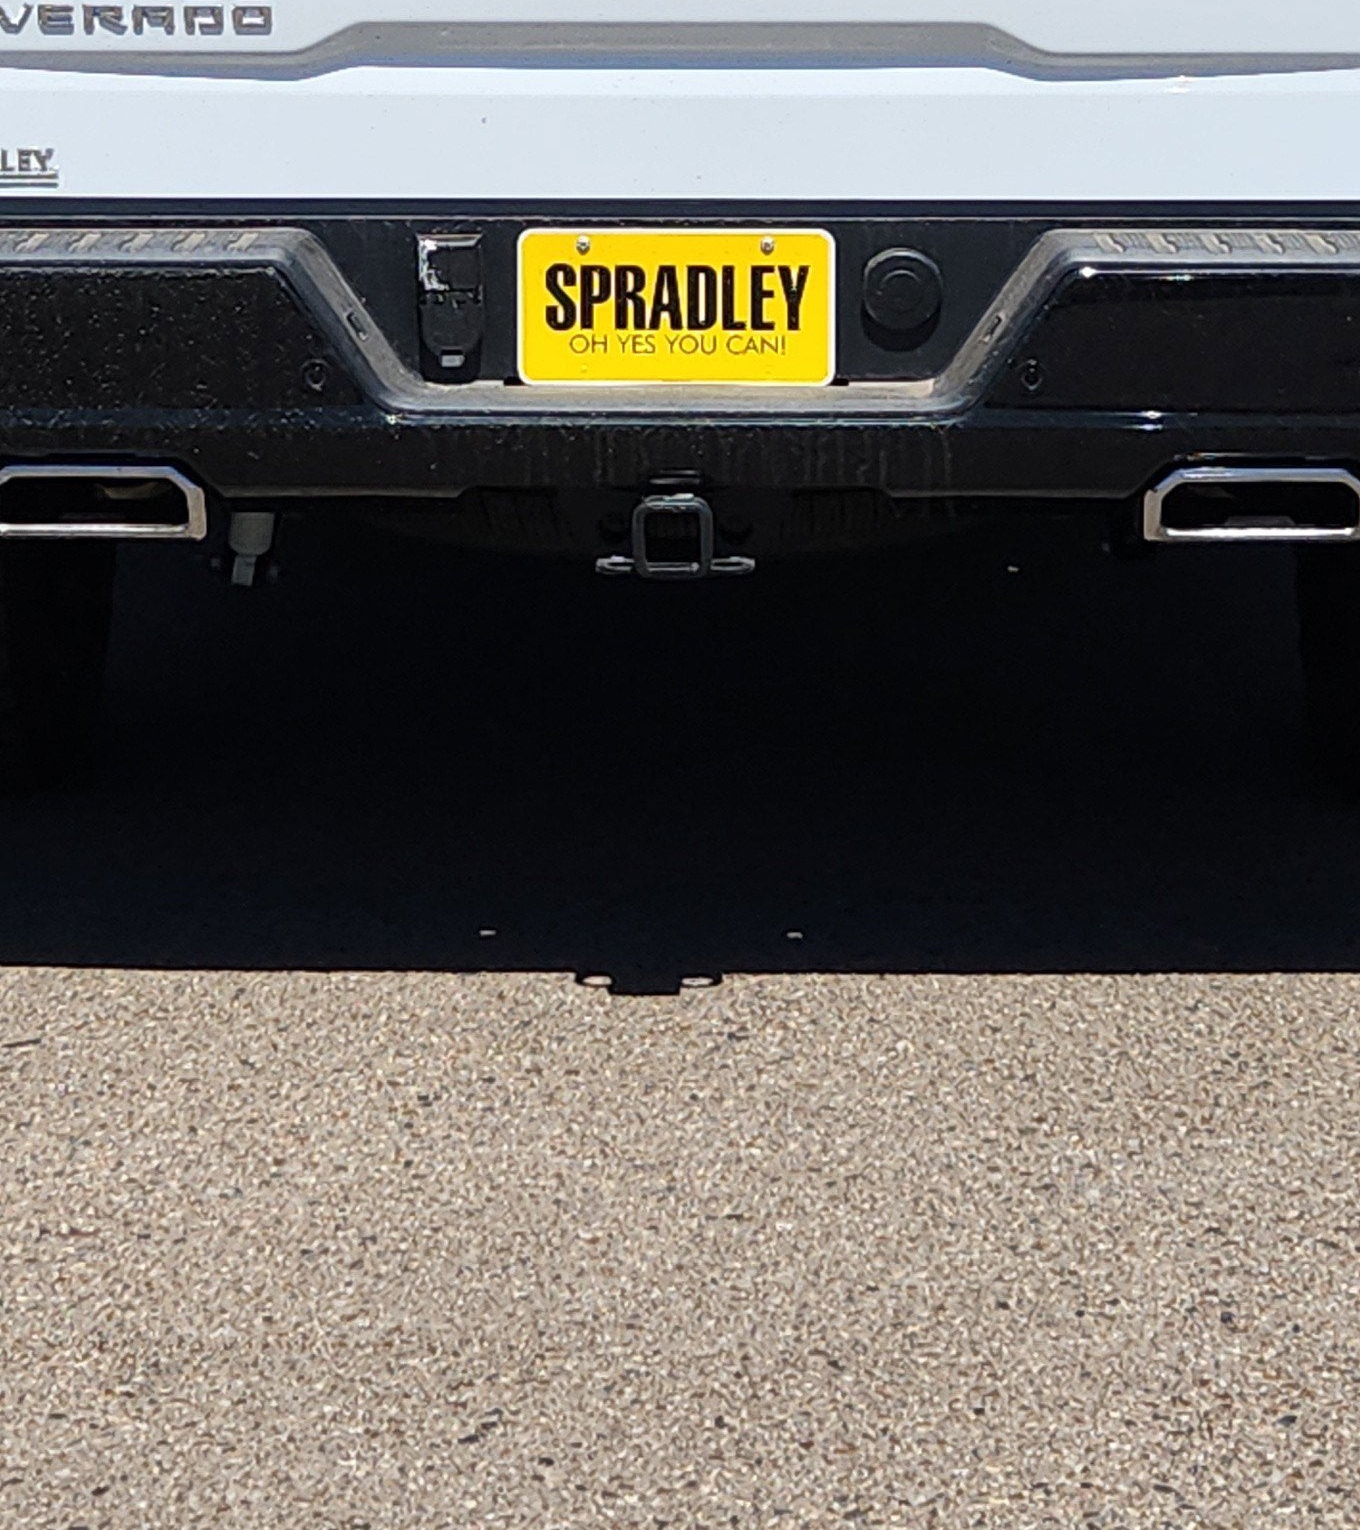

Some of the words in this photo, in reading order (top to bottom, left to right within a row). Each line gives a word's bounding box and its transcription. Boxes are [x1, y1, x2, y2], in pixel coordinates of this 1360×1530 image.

[545, 262, 811, 332] SPRADLEY
[568, 334, 608, 355] OH
[617, 334, 656, 355] YES
[665, 334, 718, 355] YOU
[725, 334, 788, 356] CAN!
